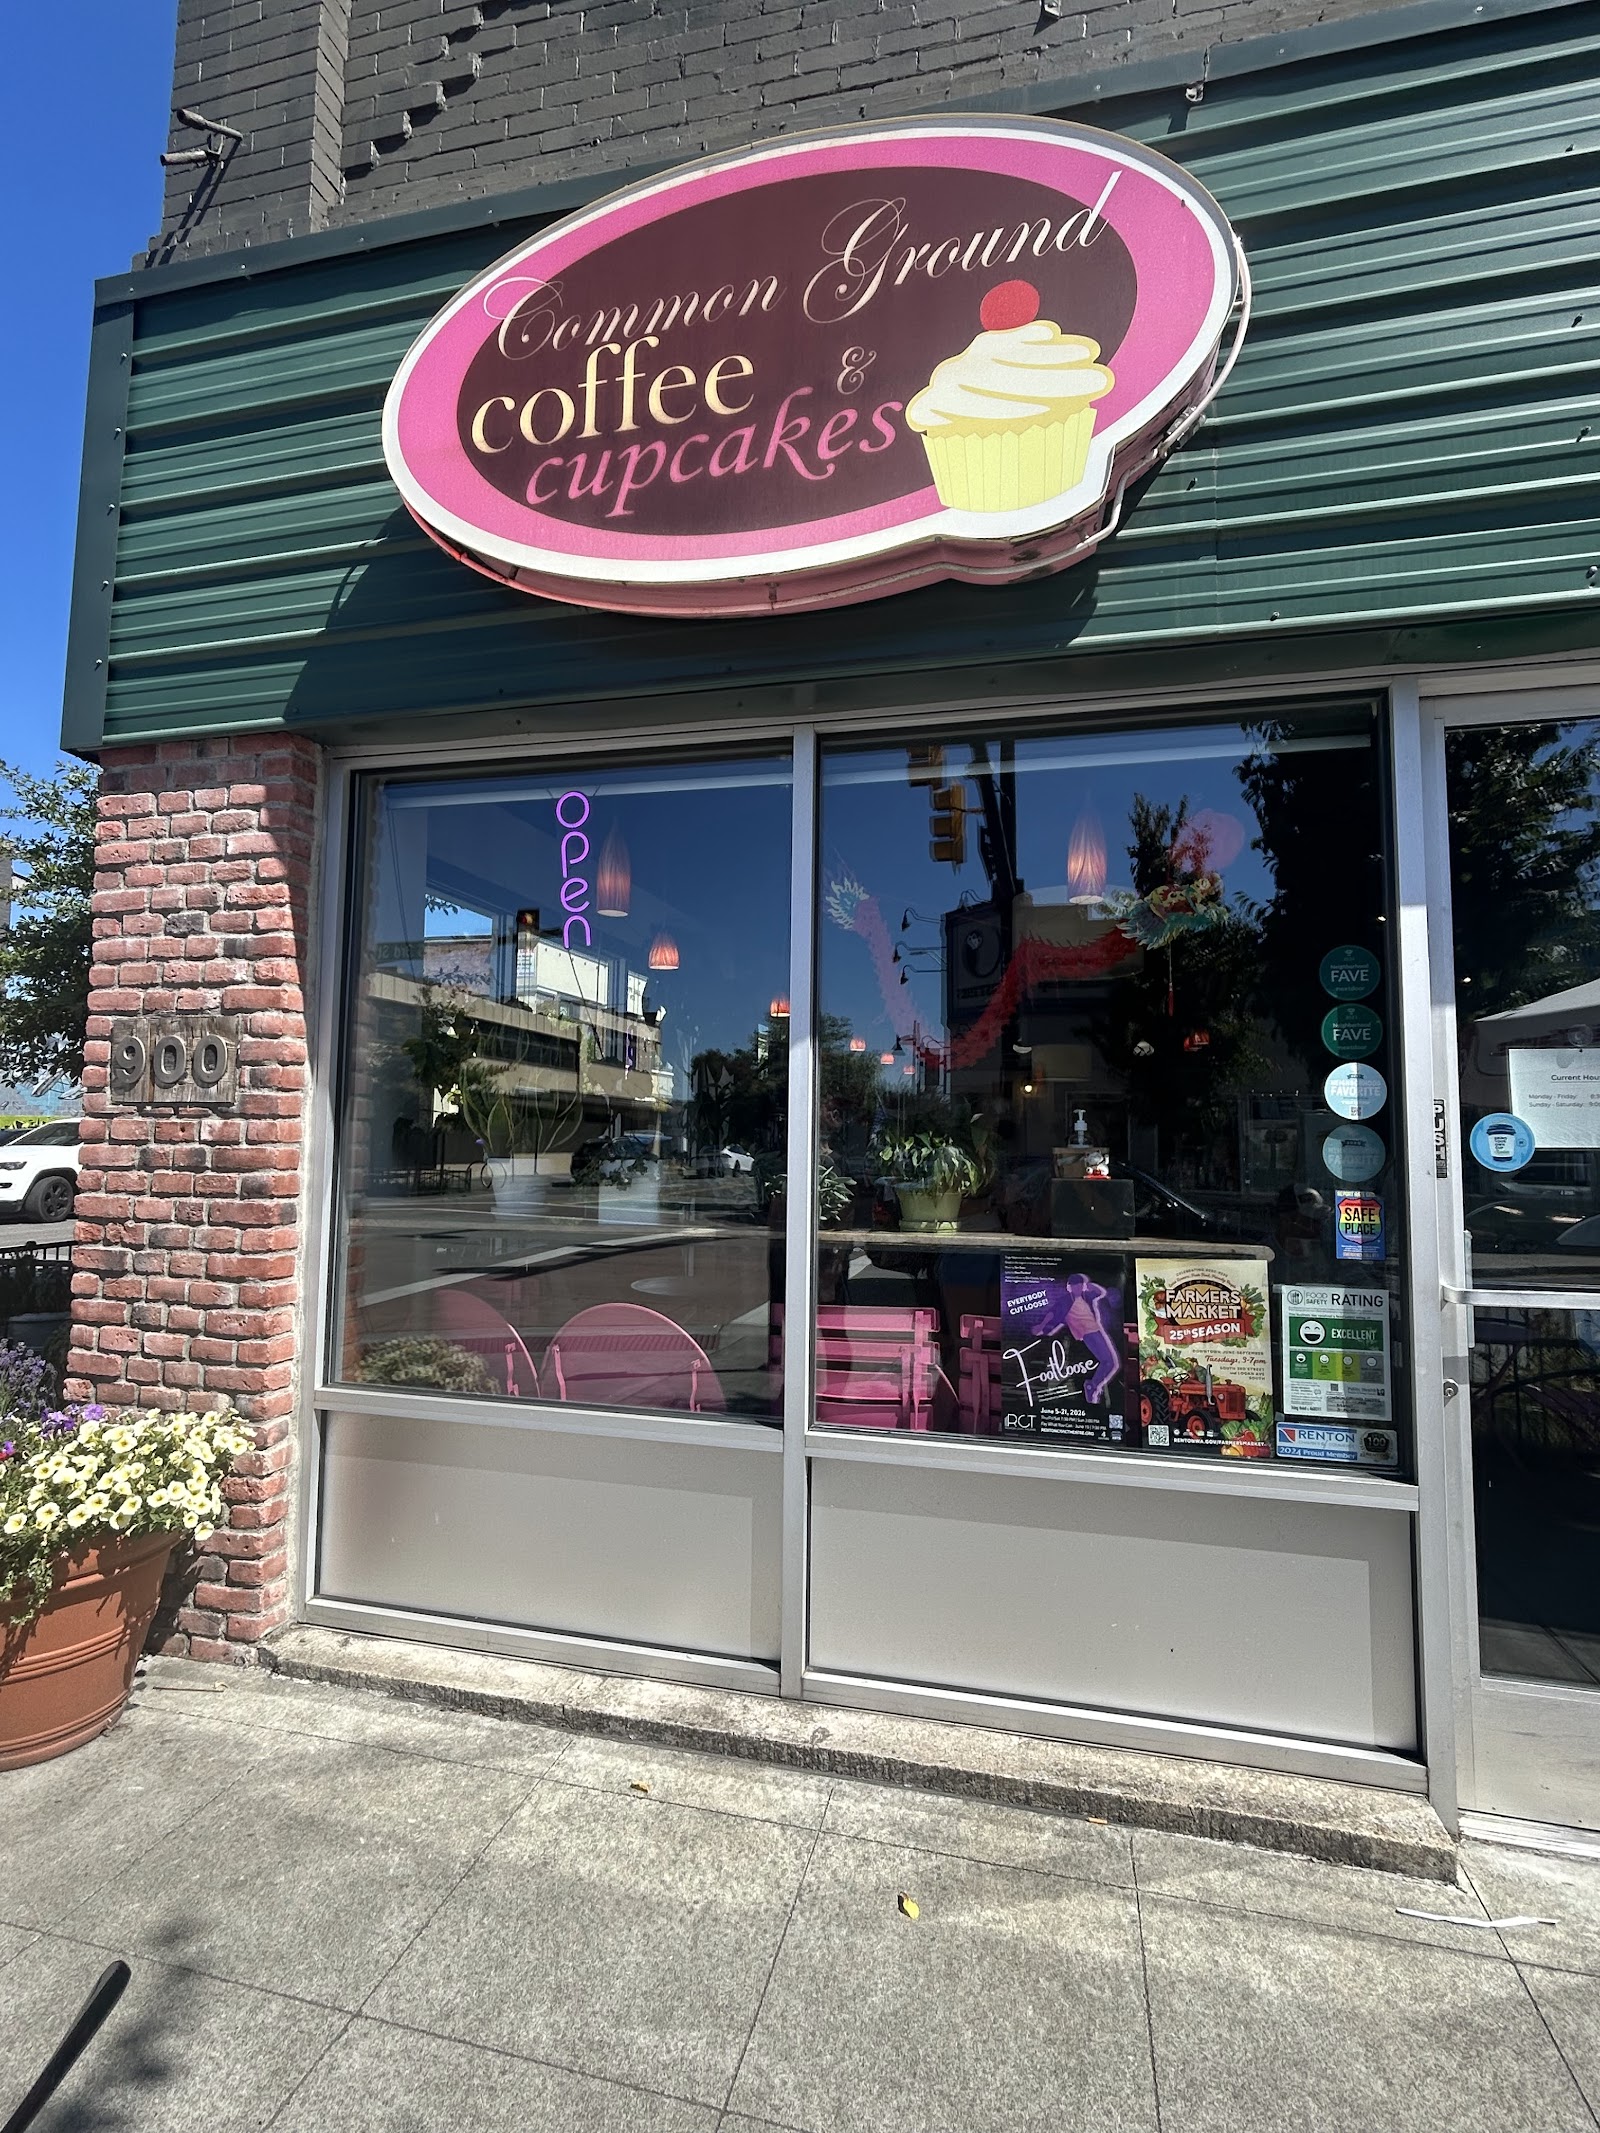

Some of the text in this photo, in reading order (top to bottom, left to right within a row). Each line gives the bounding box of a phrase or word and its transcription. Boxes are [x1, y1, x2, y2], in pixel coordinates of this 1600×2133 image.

[483, 170, 1123, 360] Common Ground
[836, 346, 877, 395] &
[471, 335, 755, 454] coffee
[525, 386, 903, 518] cupcakes
[1330, 969, 1370, 982] FAVE
[1333, 1028, 1371, 1041] FAVE
[115, 1034, 229, 1085] 900
[1330, 1086, 1381, 1097] FAVORITE
[1344, 1207, 1376, 1222] SAFE
[1345, 1223, 1376, 1235] PLACE
[1007, 1290, 1047, 1308] EVERYBODY
[1165, 1289, 1241, 1304] FARMERS
[1305, 1291, 1328, 1299] FOOD
[1331, 1293, 1384, 1307] RATING
[1010, 1298, 1049, 1315] CUT LOOSE!
[1165, 1304, 1241, 1319] MARKET
[1169, 1323, 1241, 1340] 25th SEASON
[1331, 1328, 1377, 1341] EXCELLENT
[1205, 1355, 1267, 1366] Tuesdays, 3-7pm
[1002, 1339, 1100, 1407] Footloose
[1040, 1406, 1054, 1414] June
[1055, 1408, 1069, 1416] 5-21,
[1007, 1413, 1037, 1429] RCT
[1298, 1429, 1355, 1443] RENTON
[1367, 1436, 1386, 1447] 100
[1280, 1446, 1301, 1456] 2024
[1303, 1449, 1325, 1457] Proud
[1326, 1451, 1356, 1459] Member
